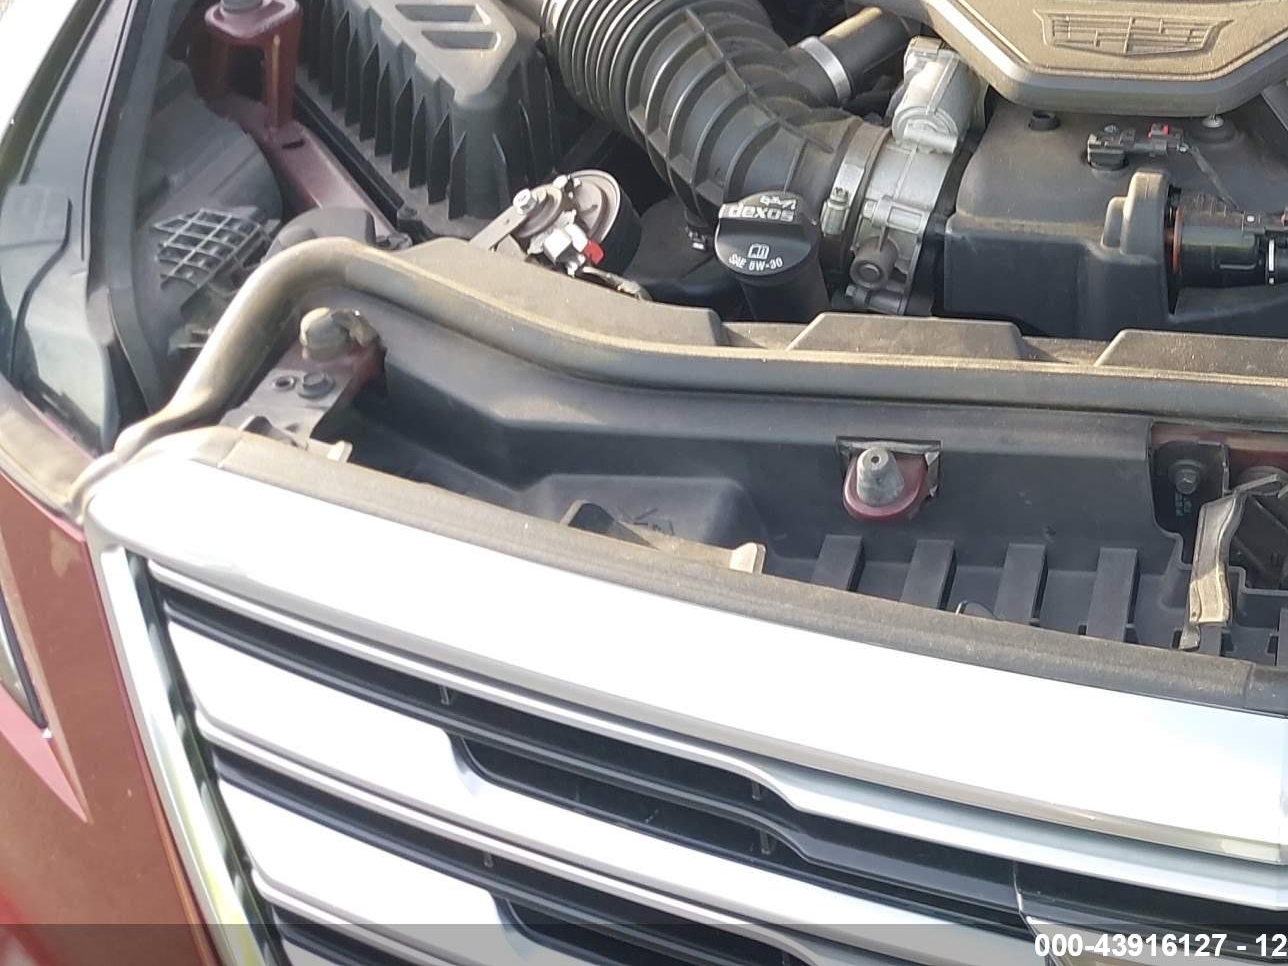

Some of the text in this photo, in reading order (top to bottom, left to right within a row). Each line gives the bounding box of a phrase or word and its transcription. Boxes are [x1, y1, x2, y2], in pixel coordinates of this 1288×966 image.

[728, 203, 795, 222] dexos
[729, 253, 783, 270] SAE 5W-30
